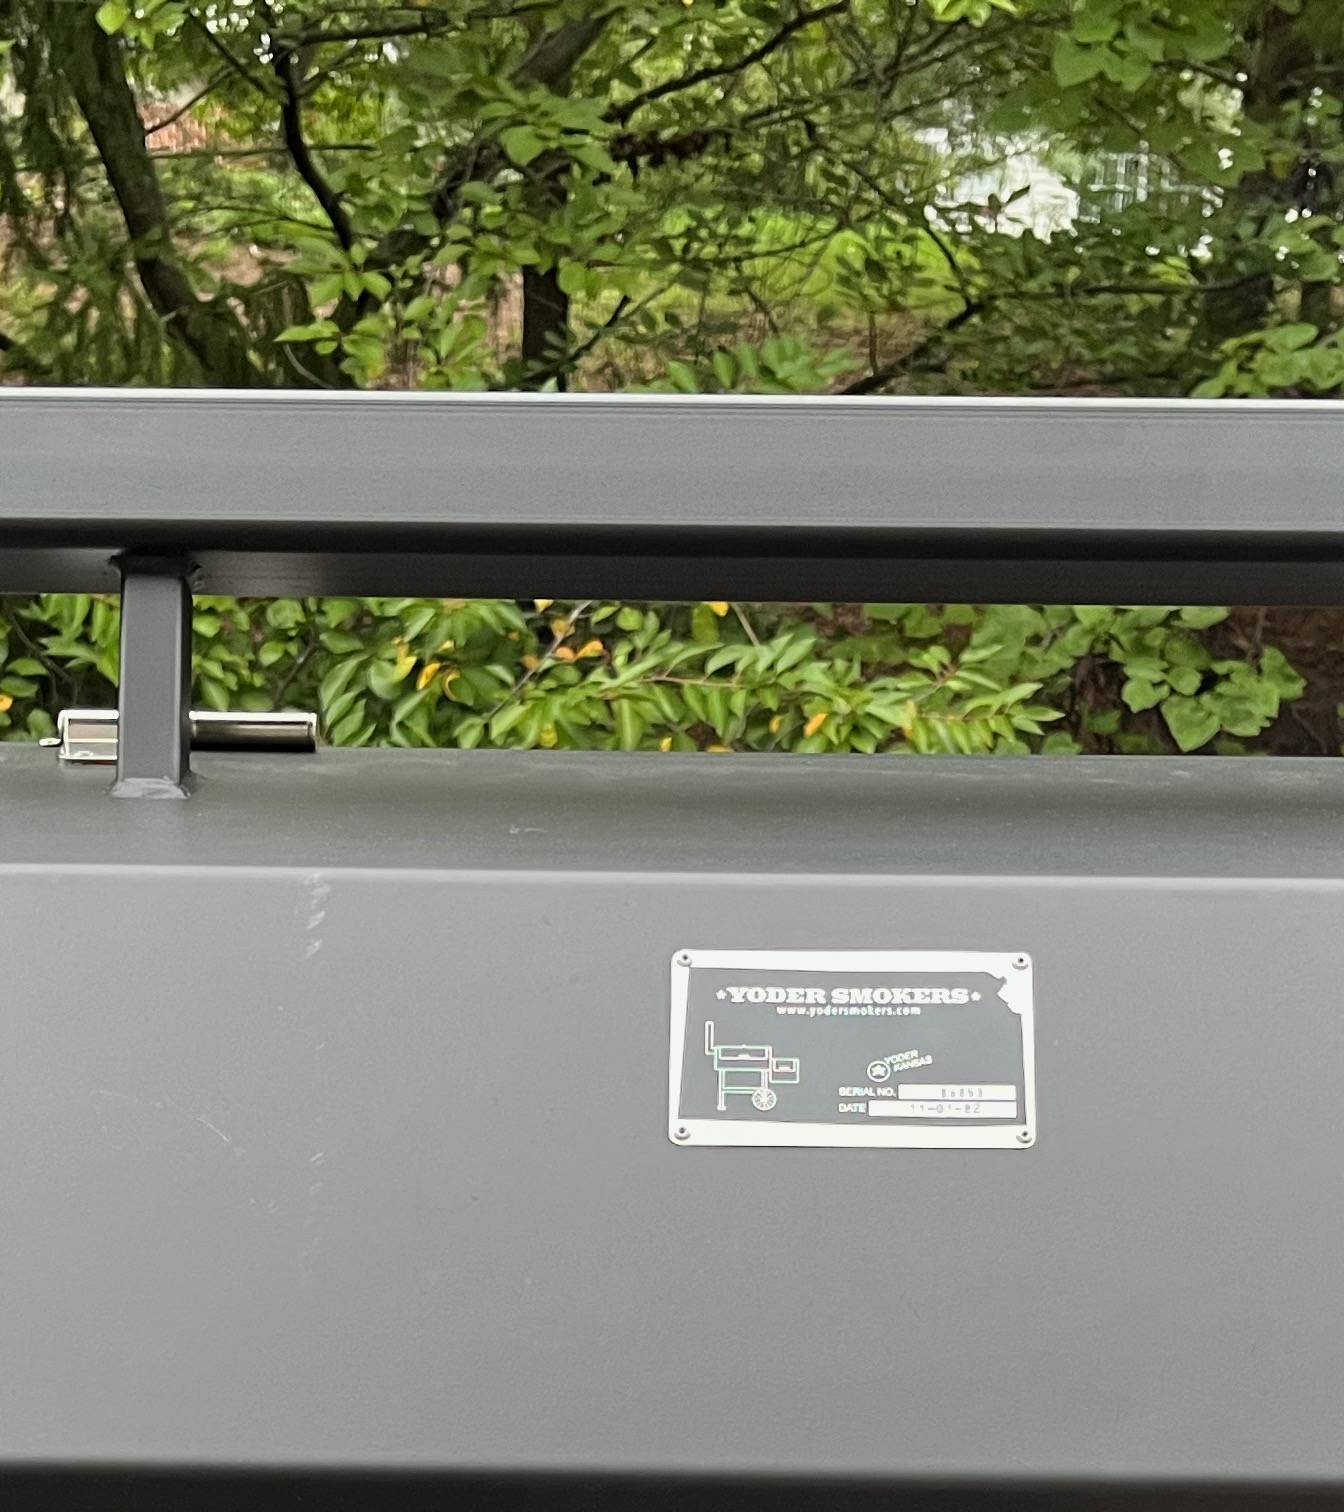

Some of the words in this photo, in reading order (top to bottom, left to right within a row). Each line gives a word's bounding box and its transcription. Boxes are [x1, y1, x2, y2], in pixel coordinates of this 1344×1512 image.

[726, 987, 826, 1003] YODER
[831, 988, 969, 1004] SMOKERS
[776, 1005, 921, 1017] www.yodersmokers.com
[883, 1049, 919, 1064] YODER
[893, 1055, 933, 1072] KANSAS
[838, 1087, 876, 1097] SERIAL
[838, 1103, 867, 1113] DATE
